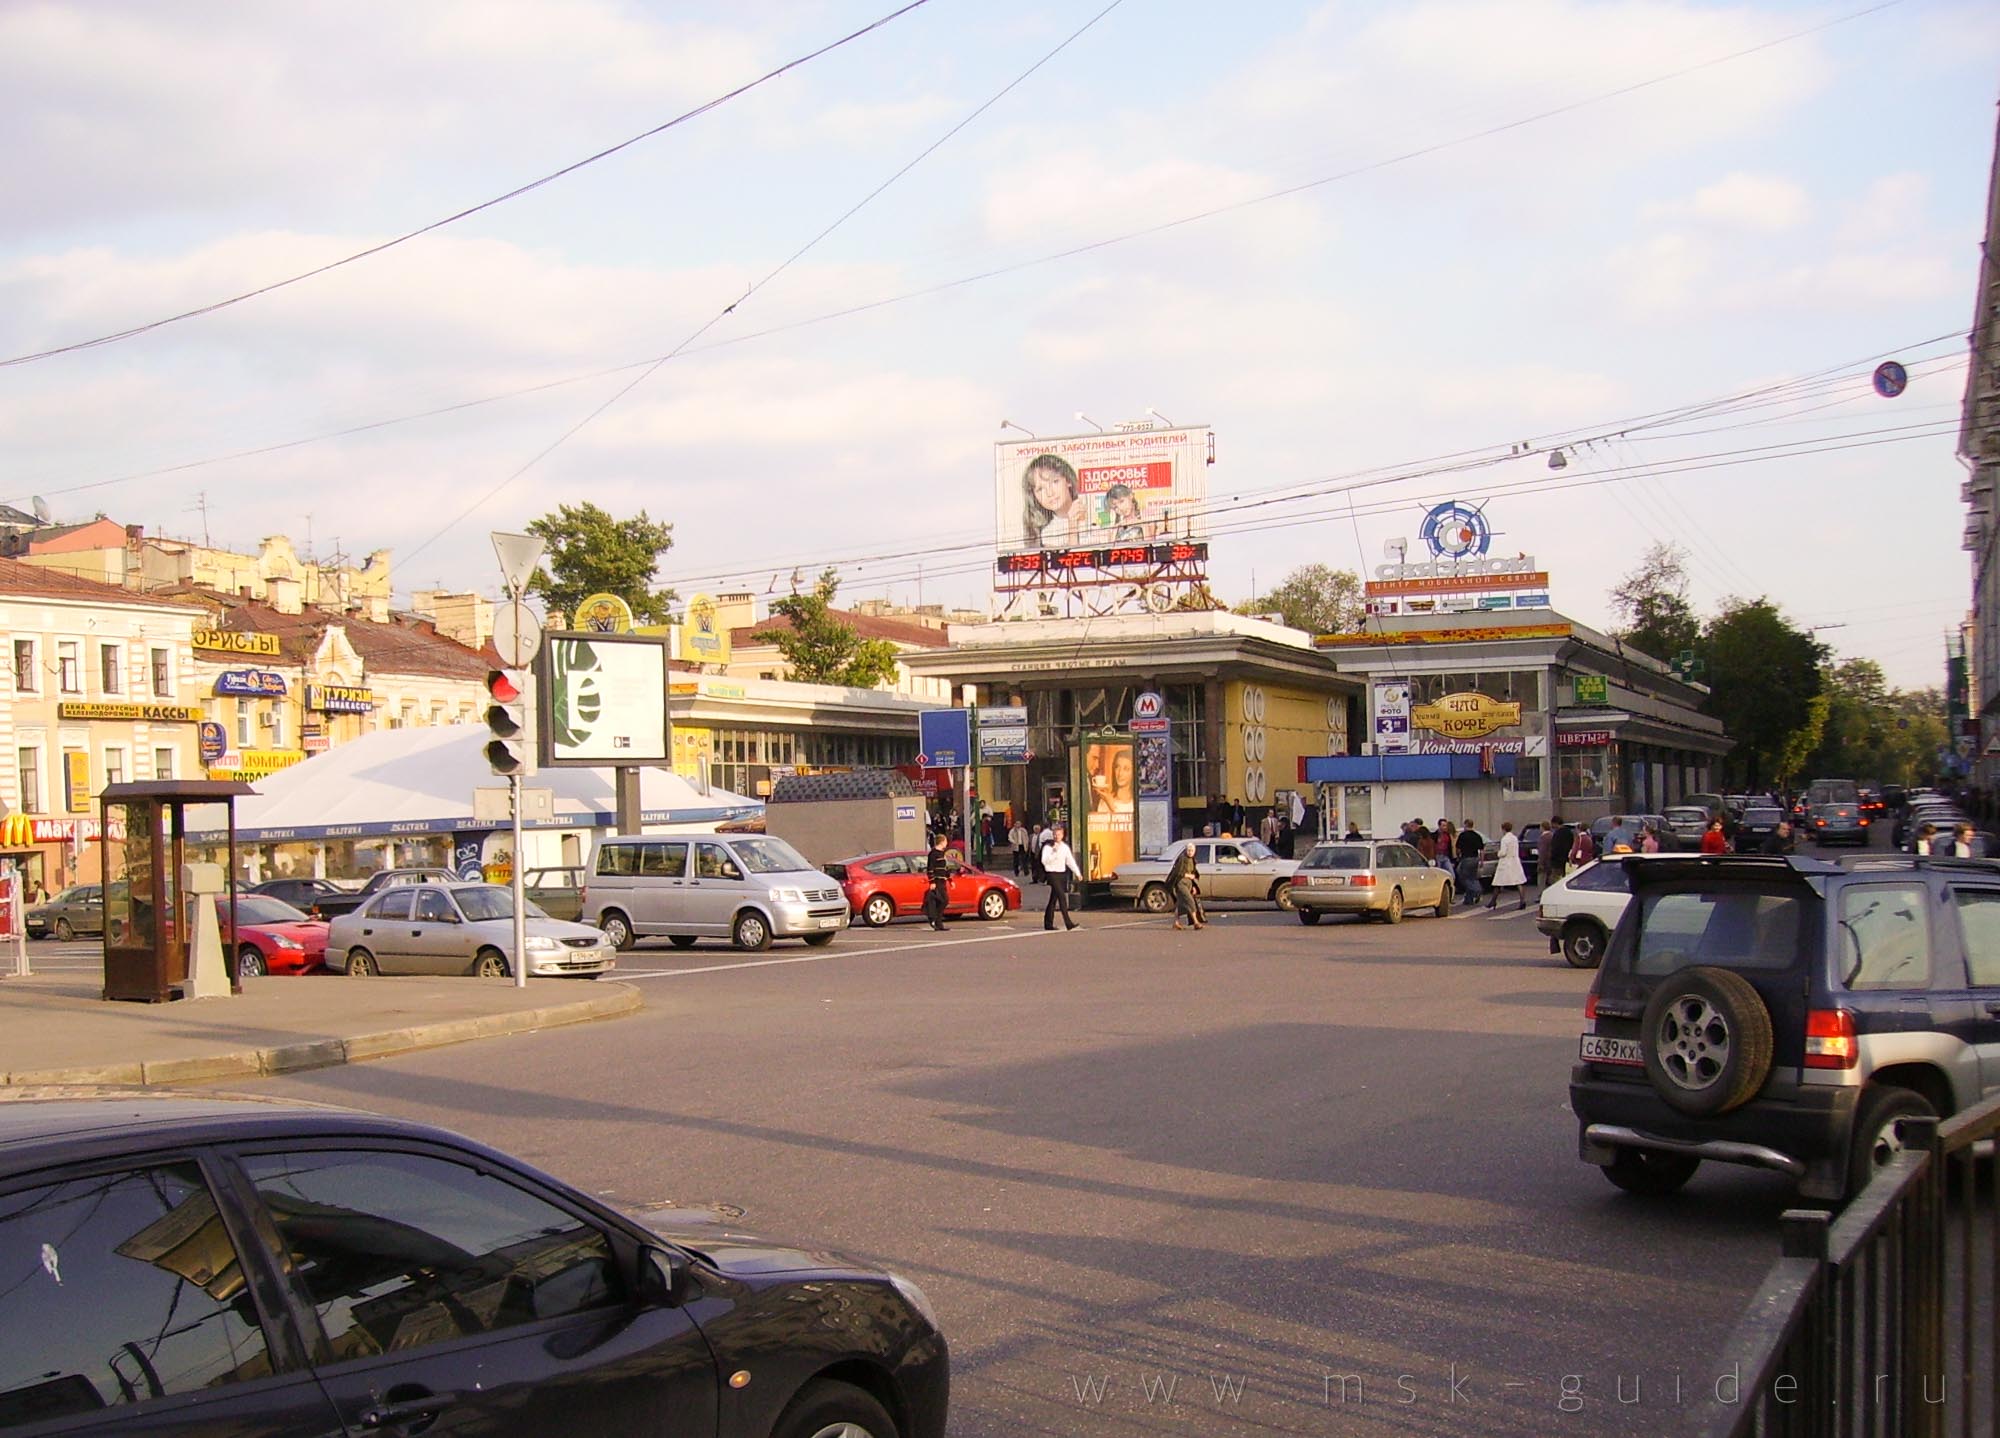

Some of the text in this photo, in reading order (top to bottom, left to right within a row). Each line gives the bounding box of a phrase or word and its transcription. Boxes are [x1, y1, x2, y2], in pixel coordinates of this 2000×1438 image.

[1016, 432, 1187, 456] ЖУРНАЛ ЗАБОТЛИВЫХ РОДИТЕЛЕЙ
[1084, 466, 1148, 483] ЗДОРОВЬЕ
[1375, 553, 1536, 580] СВЯЗНОЙ
[1374, 580, 1410, 590] ЦЕНТР
[1499, 574, 1537, 583] СВЯЗИ
[987, 581, 1180, 622] МЕТРО
[1011, 663, 1051, 671] СТАНЦИЯ
[325, 700, 372, 711] АВИАКАССЫ
[1140, 698, 1155, 712] М
[142, 706, 189, 719] КАССЫ
[1443, 718, 1487, 732] КОФЕ
[1557, 733, 1597, 745] ЦВЕТЫ
